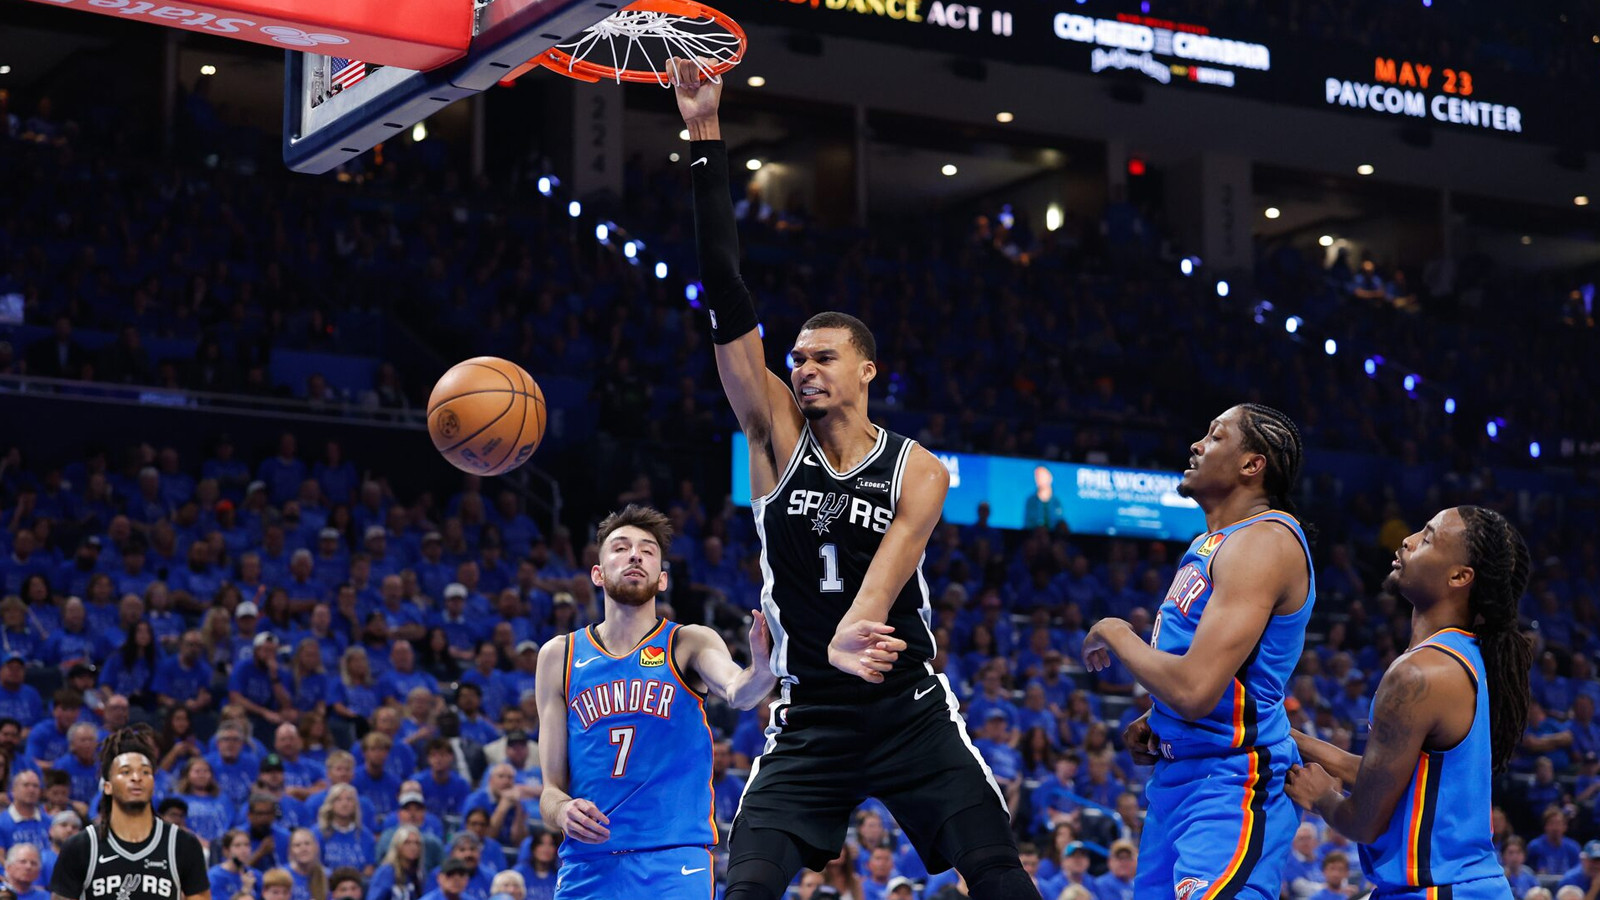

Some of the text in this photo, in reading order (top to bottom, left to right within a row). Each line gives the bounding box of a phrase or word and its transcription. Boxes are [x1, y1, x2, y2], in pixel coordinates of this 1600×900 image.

[927, 1, 982, 31] ACT
[1374, 56, 1474, 96] MAY 23
[1325, 77, 1523, 133] PAYCOM CENTER
[818, 542, 844, 593] 1
[570, 679, 676, 730] THUNDER
[609, 725, 637, 778] 7
